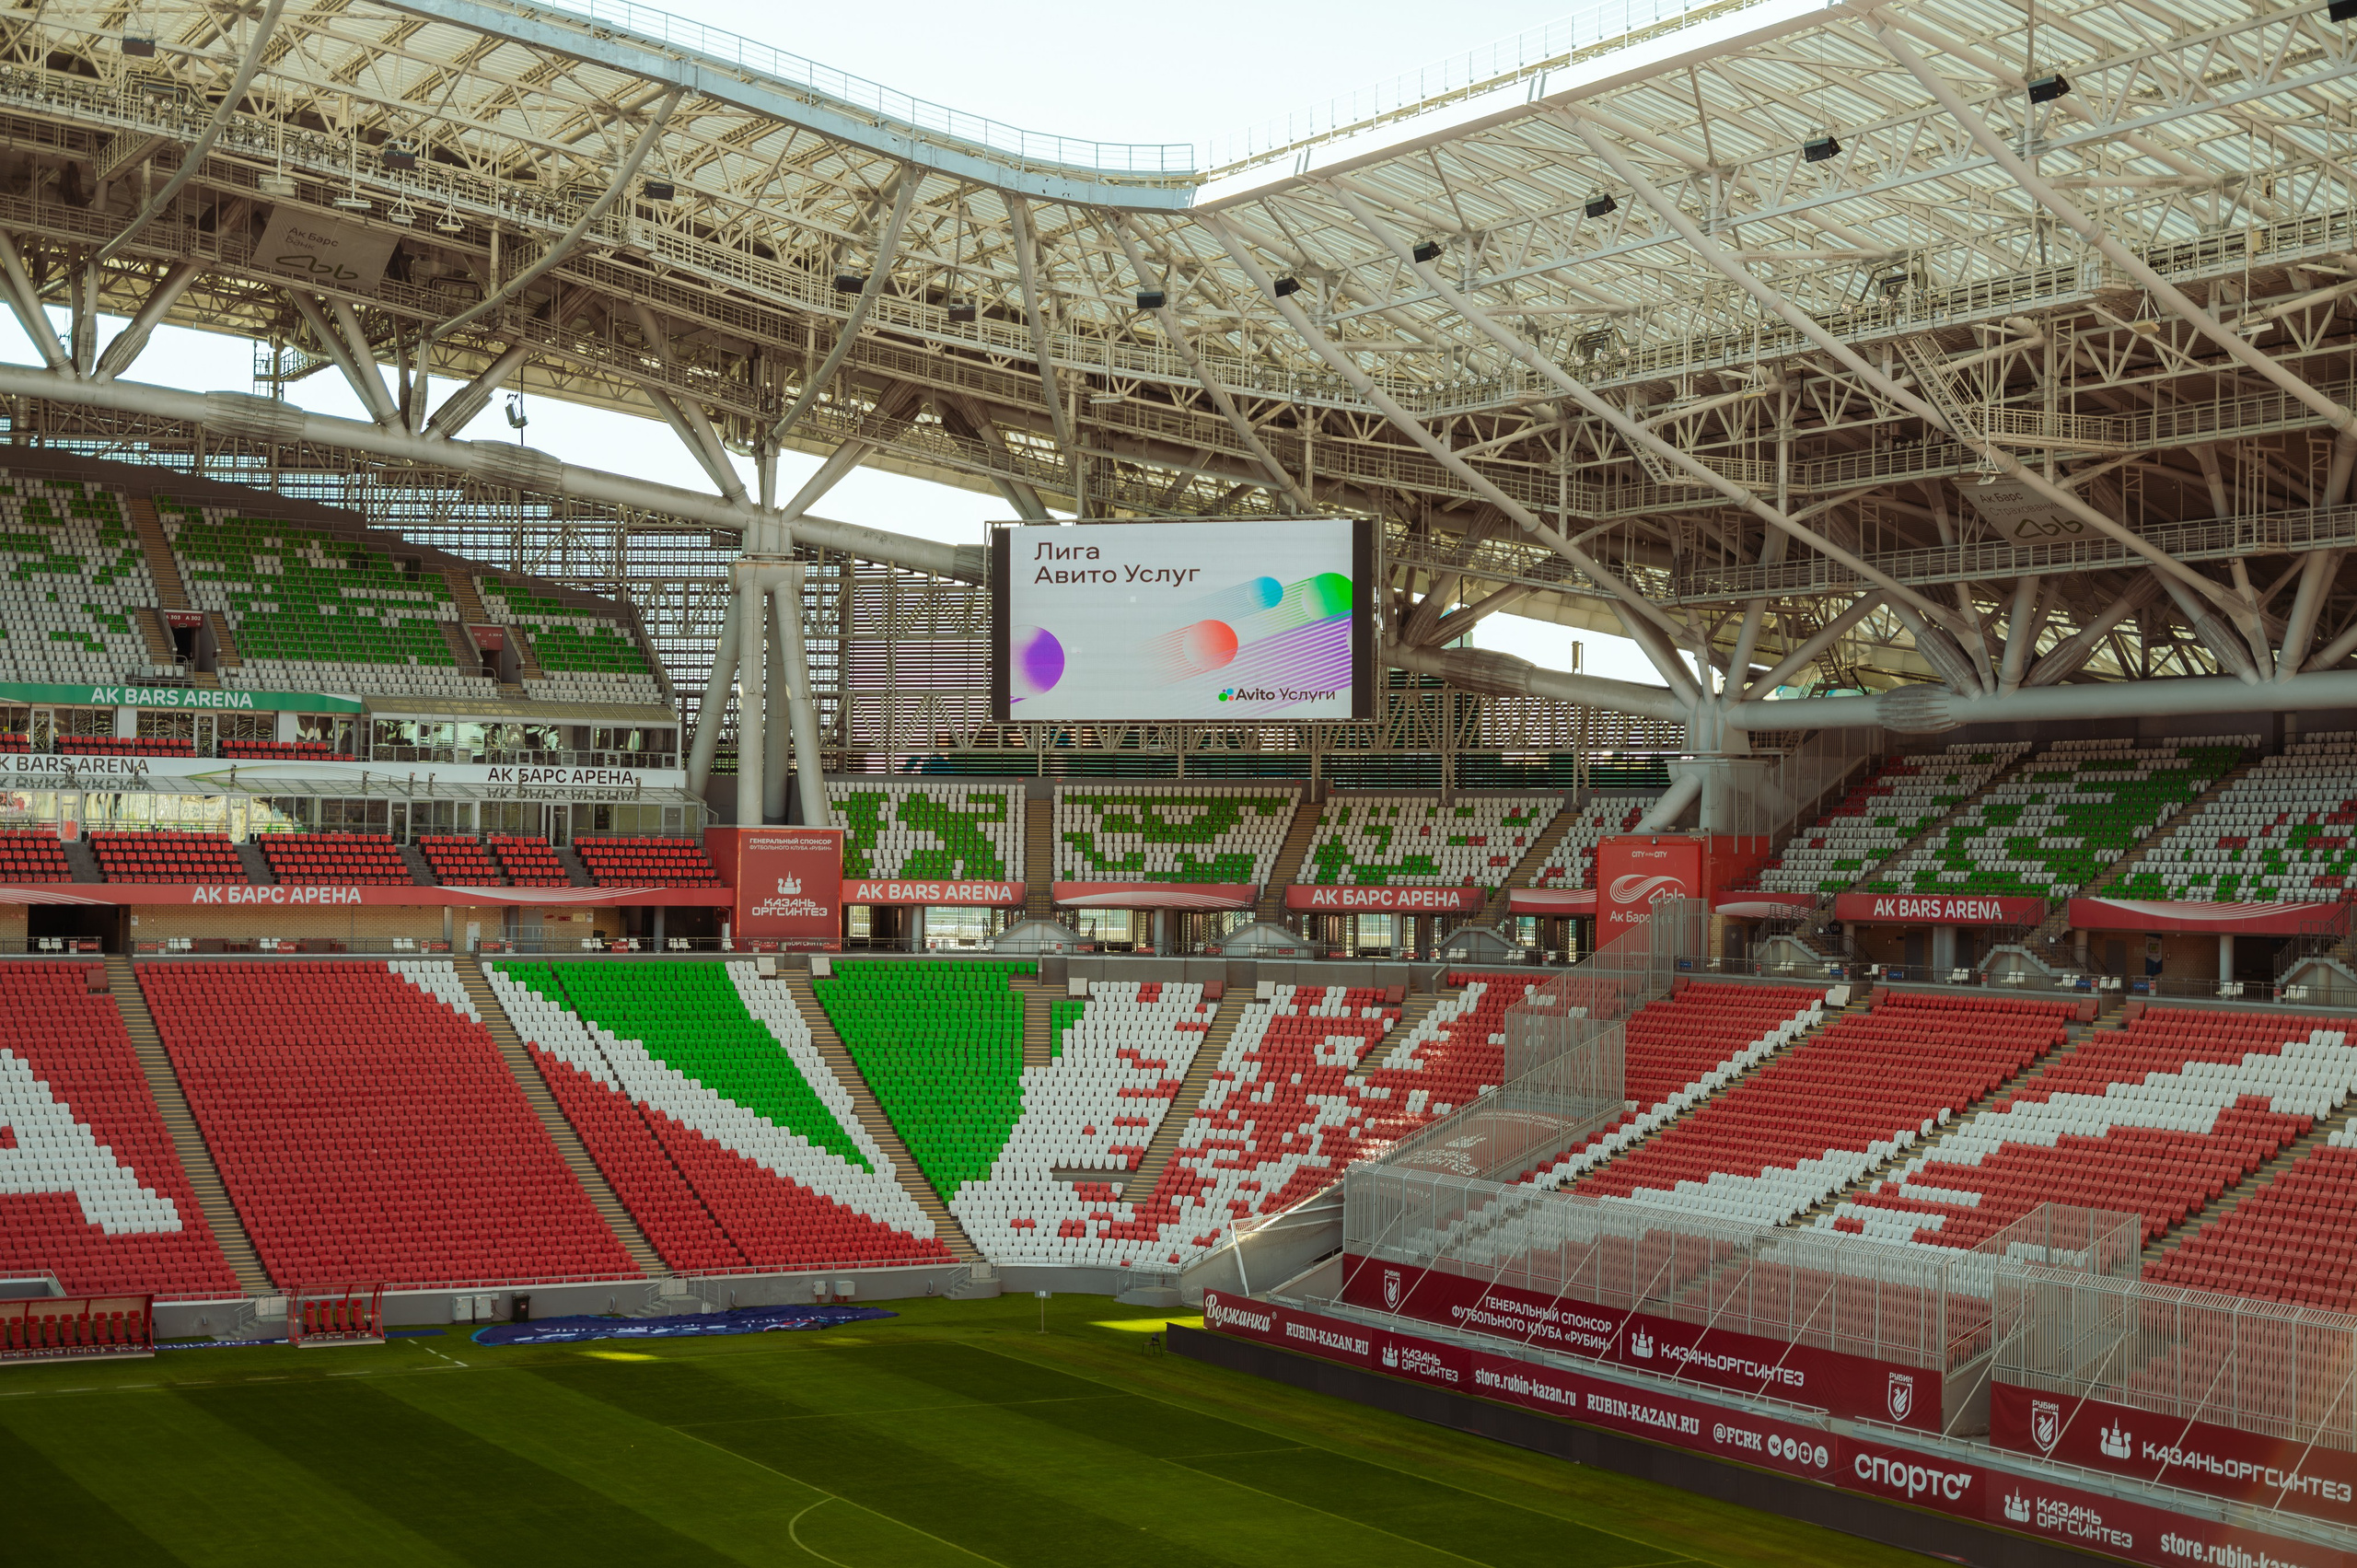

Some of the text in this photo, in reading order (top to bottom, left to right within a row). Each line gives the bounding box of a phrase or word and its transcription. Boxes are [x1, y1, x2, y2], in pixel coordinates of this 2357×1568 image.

[284, 234, 316, 251] Банк
[308, 232, 340, 248] Барс
[1994, 491, 2024, 504] Барс
[1034, 541, 1100, 561] Лига
[1034, 563, 1201, 587] Авито Услуг
[91, 687, 253, 708] AK BARS ARENA
[1235, 688, 1336, 703] Avito Услуги
[0, 755, 150, 774] K BARS ARENA
[488, 767, 634, 785] АК БАРС АРЕНА
[192, 887, 362, 904] АК БАРС АРЕНА
[856, 884, 1013, 901] AK BARS ARENA
[1312, 889, 1460, 908] АК БАРС АРЕНА
[751, 907, 828, 916] ОРГСИНТЕЗ
[763, 898, 816, 907] КАЗАНЬ
[1873, 898, 2003, 921] AK BARS ARENA
[1609, 911, 1624, 923] Ак
[1451, 1304, 1526, 1333] ФУТБОЛЬНОГО
[1527, 1319, 1563, 1342] КЛУБА
[1485, 1295, 1612, 1334] ГЕНЕРАЛЬНЫЙ СПОНСОР
[1285, 1321, 1370, 1356] RUBIN-KAZAN.RU
[1401, 1346, 1442, 1365] КАЗАНЬ
[1660, 1342, 1805, 1388] КАЗАНЬОРГСИНТЕЗ
[1401, 1359, 1459, 1382] ОРГСИНТЕЗ
[1889, 1372, 1913, 1383] РУБИН
[1475, 1367, 1763, 1452] store.rubin-kazan.ru RUBIN-KAZAN.RU @FCRK
[2032, 1400, 2060, 1411] РУБИН
[2142, 1440, 2352, 1504] КАЗАНЬОРГСИНТЕЗ
[2036, 1496, 2102, 1526] КАЗАНЬ
[2036, 1512, 2133, 1550] ОРГСИНТЕЗ
